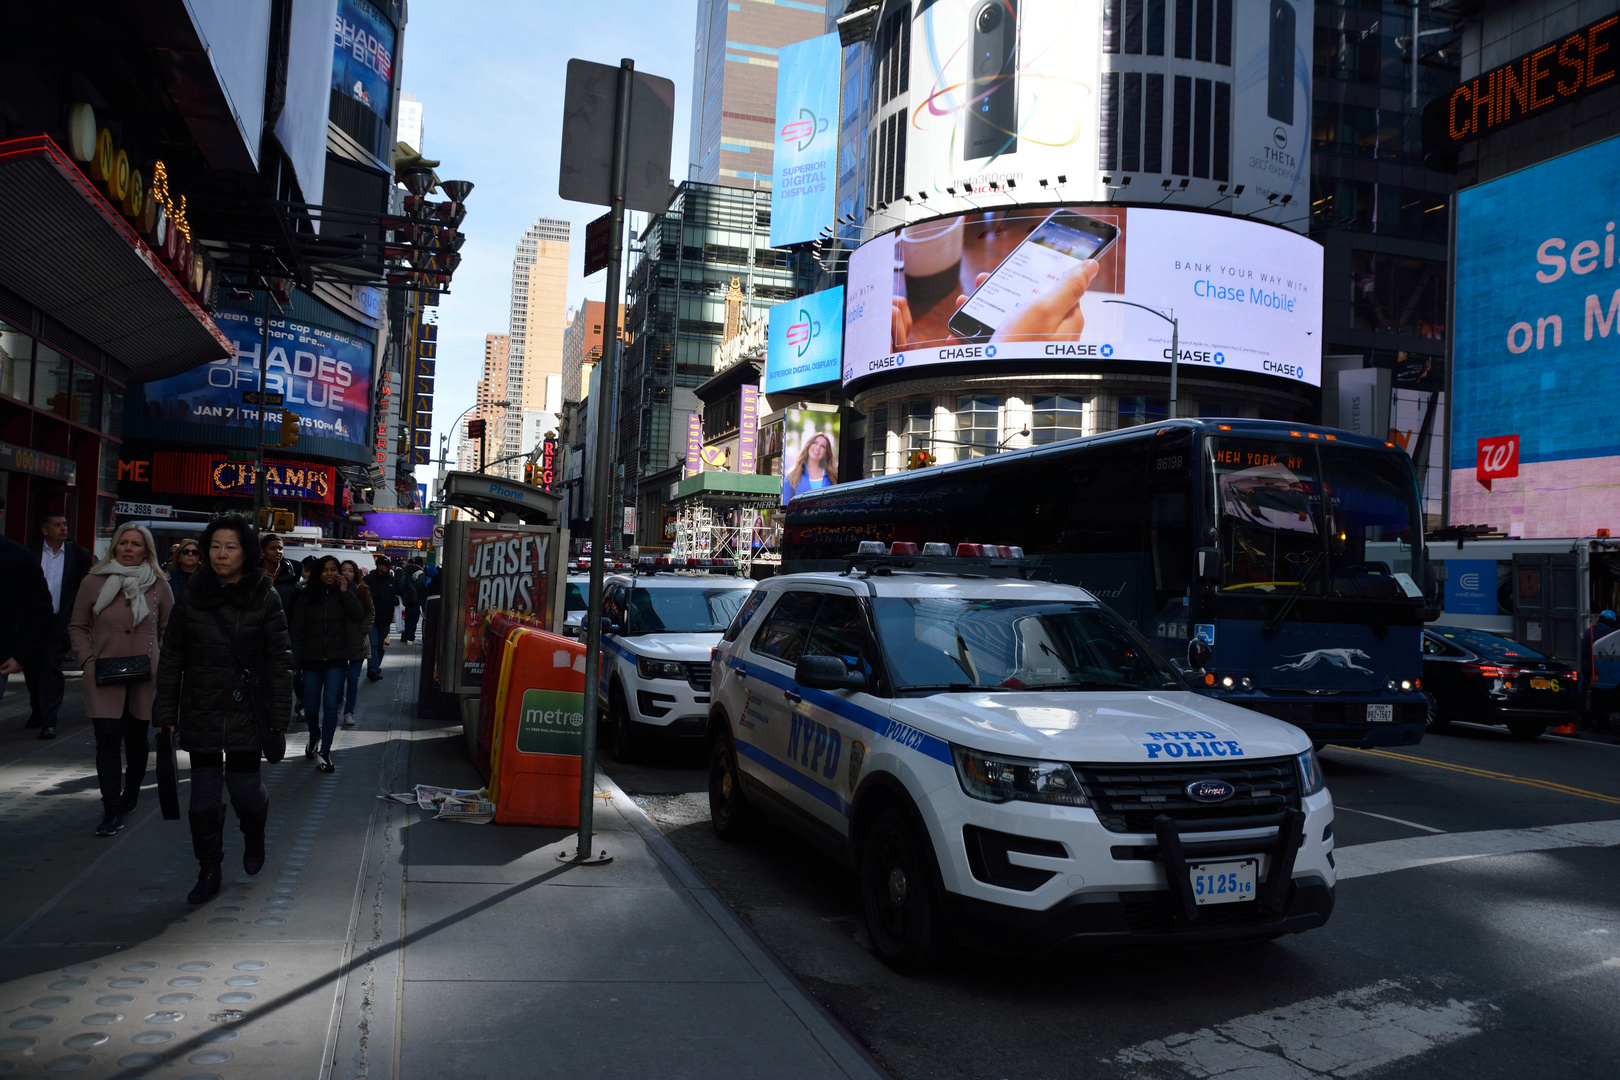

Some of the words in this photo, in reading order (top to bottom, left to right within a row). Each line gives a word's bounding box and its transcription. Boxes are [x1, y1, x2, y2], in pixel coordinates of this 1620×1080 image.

[336, 14, 392, 69] SHADES
[352, 41, 392, 83] BLUE
[1450, 16, 1619, 140] CHINESE
[782, 161, 826, 177] SUPERIOR
[1264, 146, 1295, 169] THETA
[781, 183, 826, 199] DISPLAYS
[782, 171, 826, 189] DIGITAL
[1536, 221, 1620, 283] Sei
[1175, 261, 1211, 273] BANK
[1220, 266, 1253, 279] YOUR
[1260, 273, 1281, 285] WAY
[1287, 280, 1308, 293] WITH
[1194, 280, 1245, 302] Chase
[212, 311, 248, 322] ween
[254, 317, 285, 328] god
[290, 322, 310, 335] cop
[314, 327, 332, 339] and
[334, 333, 349, 345] bad
[258, 327, 294, 340] there
[1506, 314, 1562, 354] on
[939, 347, 982, 360] CHASE
[1045, 345, 1097, 356] CHASE
[1163, 348, 1211, 363] CHASE
[209, 340, 352, 387] HADES
[769, 368, 792, 379] SUPERIOR
[793, 364, 811, 374] DIGITAL
[812, 358, 837, 370] DISPLAYS
[868, 356, 895, 371] CHASE
[1263, 360, 1295, 376] CHASE
[208, 366, 254, 389] OF
[258, 372, 345, 412] BLUE
[193, 405, 222, 417] JAN
[225, 407, 234, 418] 7
[241, 409, 313, 428] THURSAYS
[742, 388, 755, 443] VICTORY
[1352, 396, 1360, 432] UTERS
[377, 372, 391, 489] AMSTERD
[688, 416, 699, 462] VICTORY
[1156, 455, 1183, 470] 86198
[1217, 450, 1240, 464] NEW
[1247, 453, 1277, 467] YORK
[1288, 456, 1302, 469] NY
[1481, 440, 1515, 473] W
[117, 459, 150, 482] ME
[213, 462, 328, 497] CHAMPS
[490, 484, 524, 500] Phone
[469, 534, 550, 578] JERSEY
[477, 574, 533, 616] BOYS
[525, 708, 584, 727] metro
[787, 711, 841, 780] NYPD
[885, 720, 923, 751] POLICE
[1146, 731, 1216, 741] NYPD
[1142, 741, 1244, 759] POLICE
[1199, 783, 1226, 797] Ford
[1195, 873, 1237, 895] 5125
[1239, 882, 1251, 892] 16
